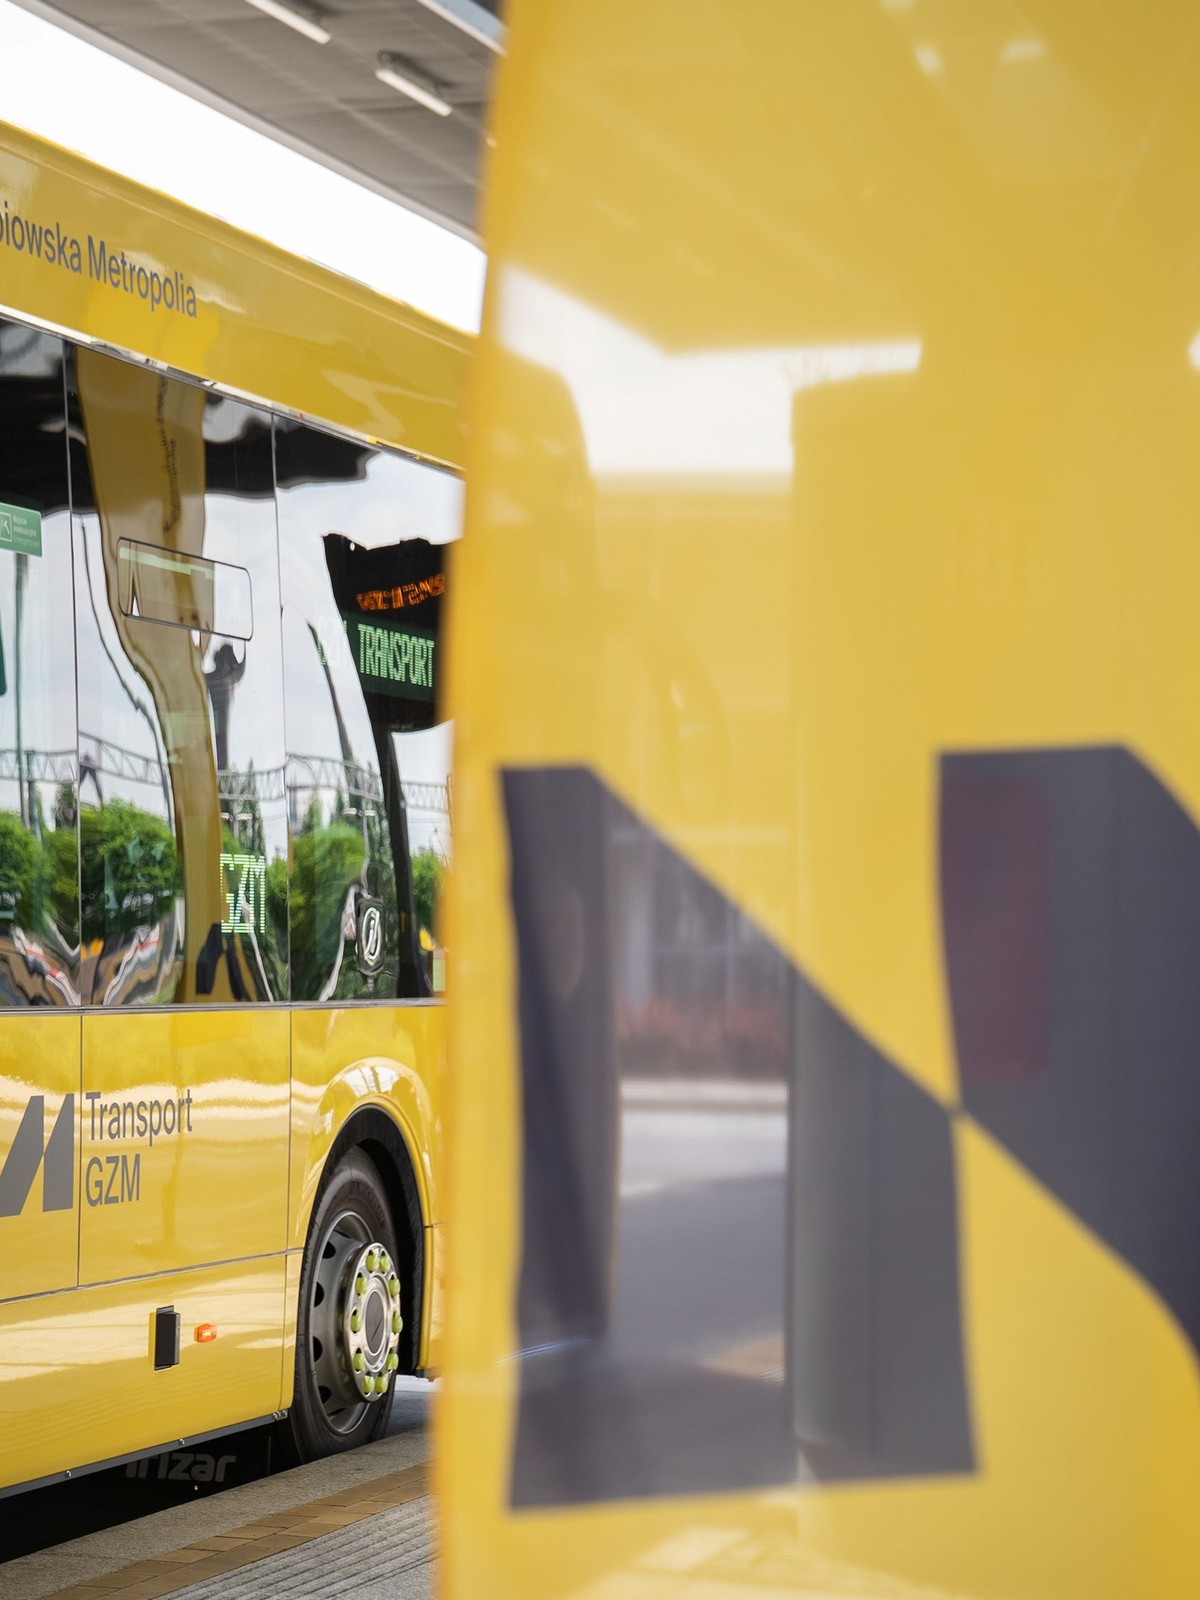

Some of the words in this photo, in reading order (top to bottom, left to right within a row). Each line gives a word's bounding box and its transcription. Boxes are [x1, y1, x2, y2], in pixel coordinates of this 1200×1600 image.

[87, 235, 197, 319] Metropolia
[358, 623, 435, 688] TRANSPORT
[85, 1089, 192, 1147] Transport
[85, 1153, 140, 1207] GZM
